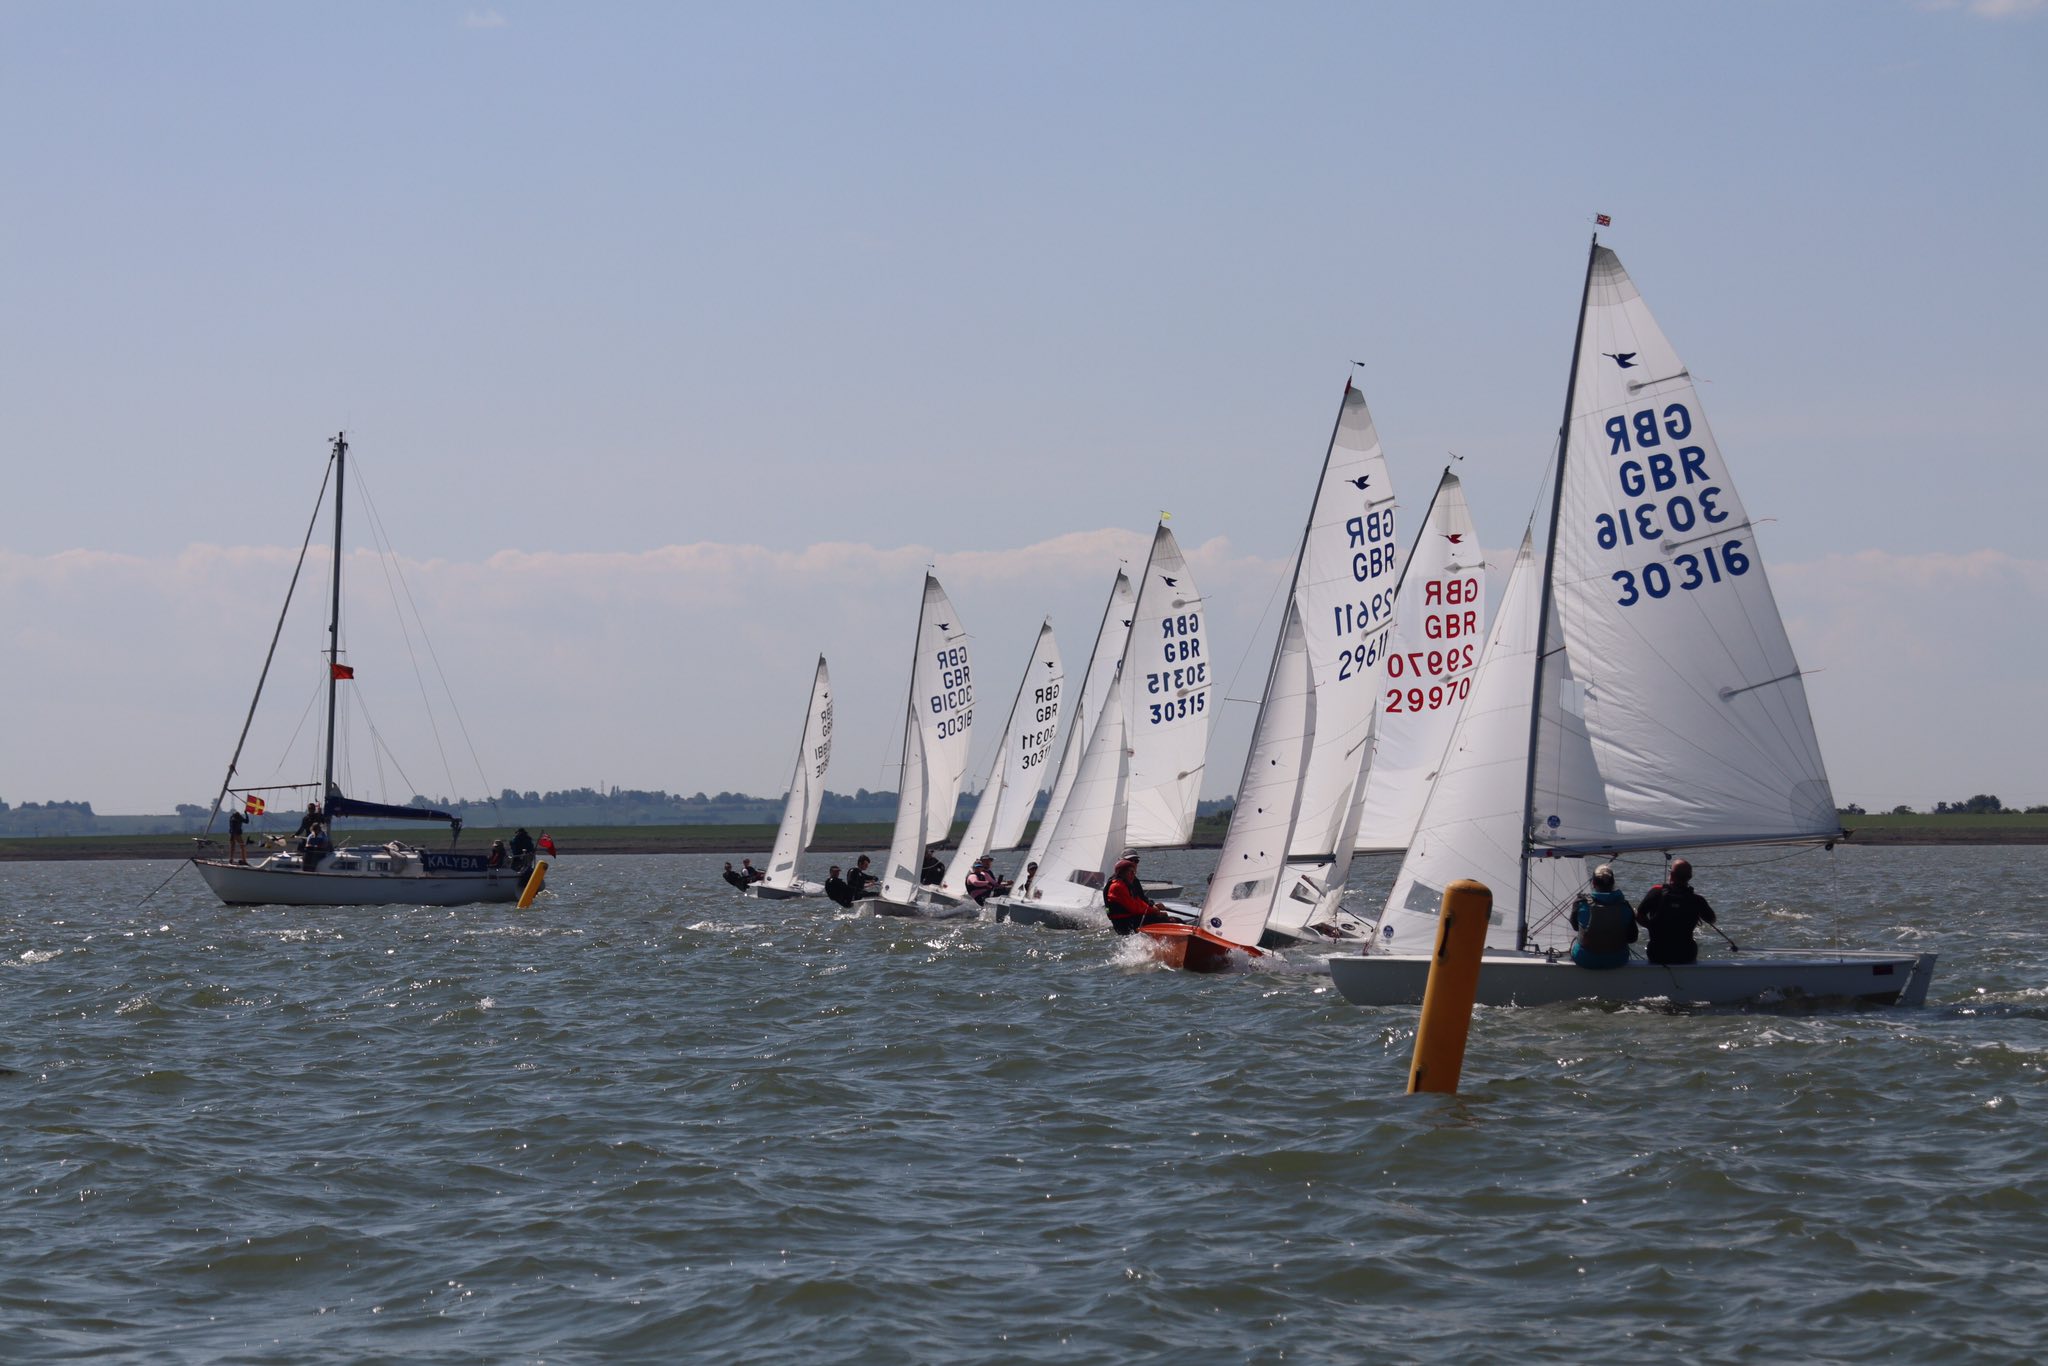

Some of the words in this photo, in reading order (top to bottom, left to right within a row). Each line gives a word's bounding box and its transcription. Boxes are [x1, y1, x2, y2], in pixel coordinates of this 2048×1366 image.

[1619, 446, 1710, 497] GBR
[1353, 542, 1394, 582] GBR
[1611, 540, 1750, 607] 30316
[1425, 610, 1476, 639] GBR
[1164, 638, 1200, 663] GBR
[1338, 630, 1389, 681] 29611
[943, 665, 971, 690] GBR
[1150, 692, 1205, 725] 30315
[1385, 677, 1470, 713] 29970
[937, 709, 973, 740] 30318
[1036, 703, 1058, 723] GBR
[427, 855, 480, 869] KALYBA
